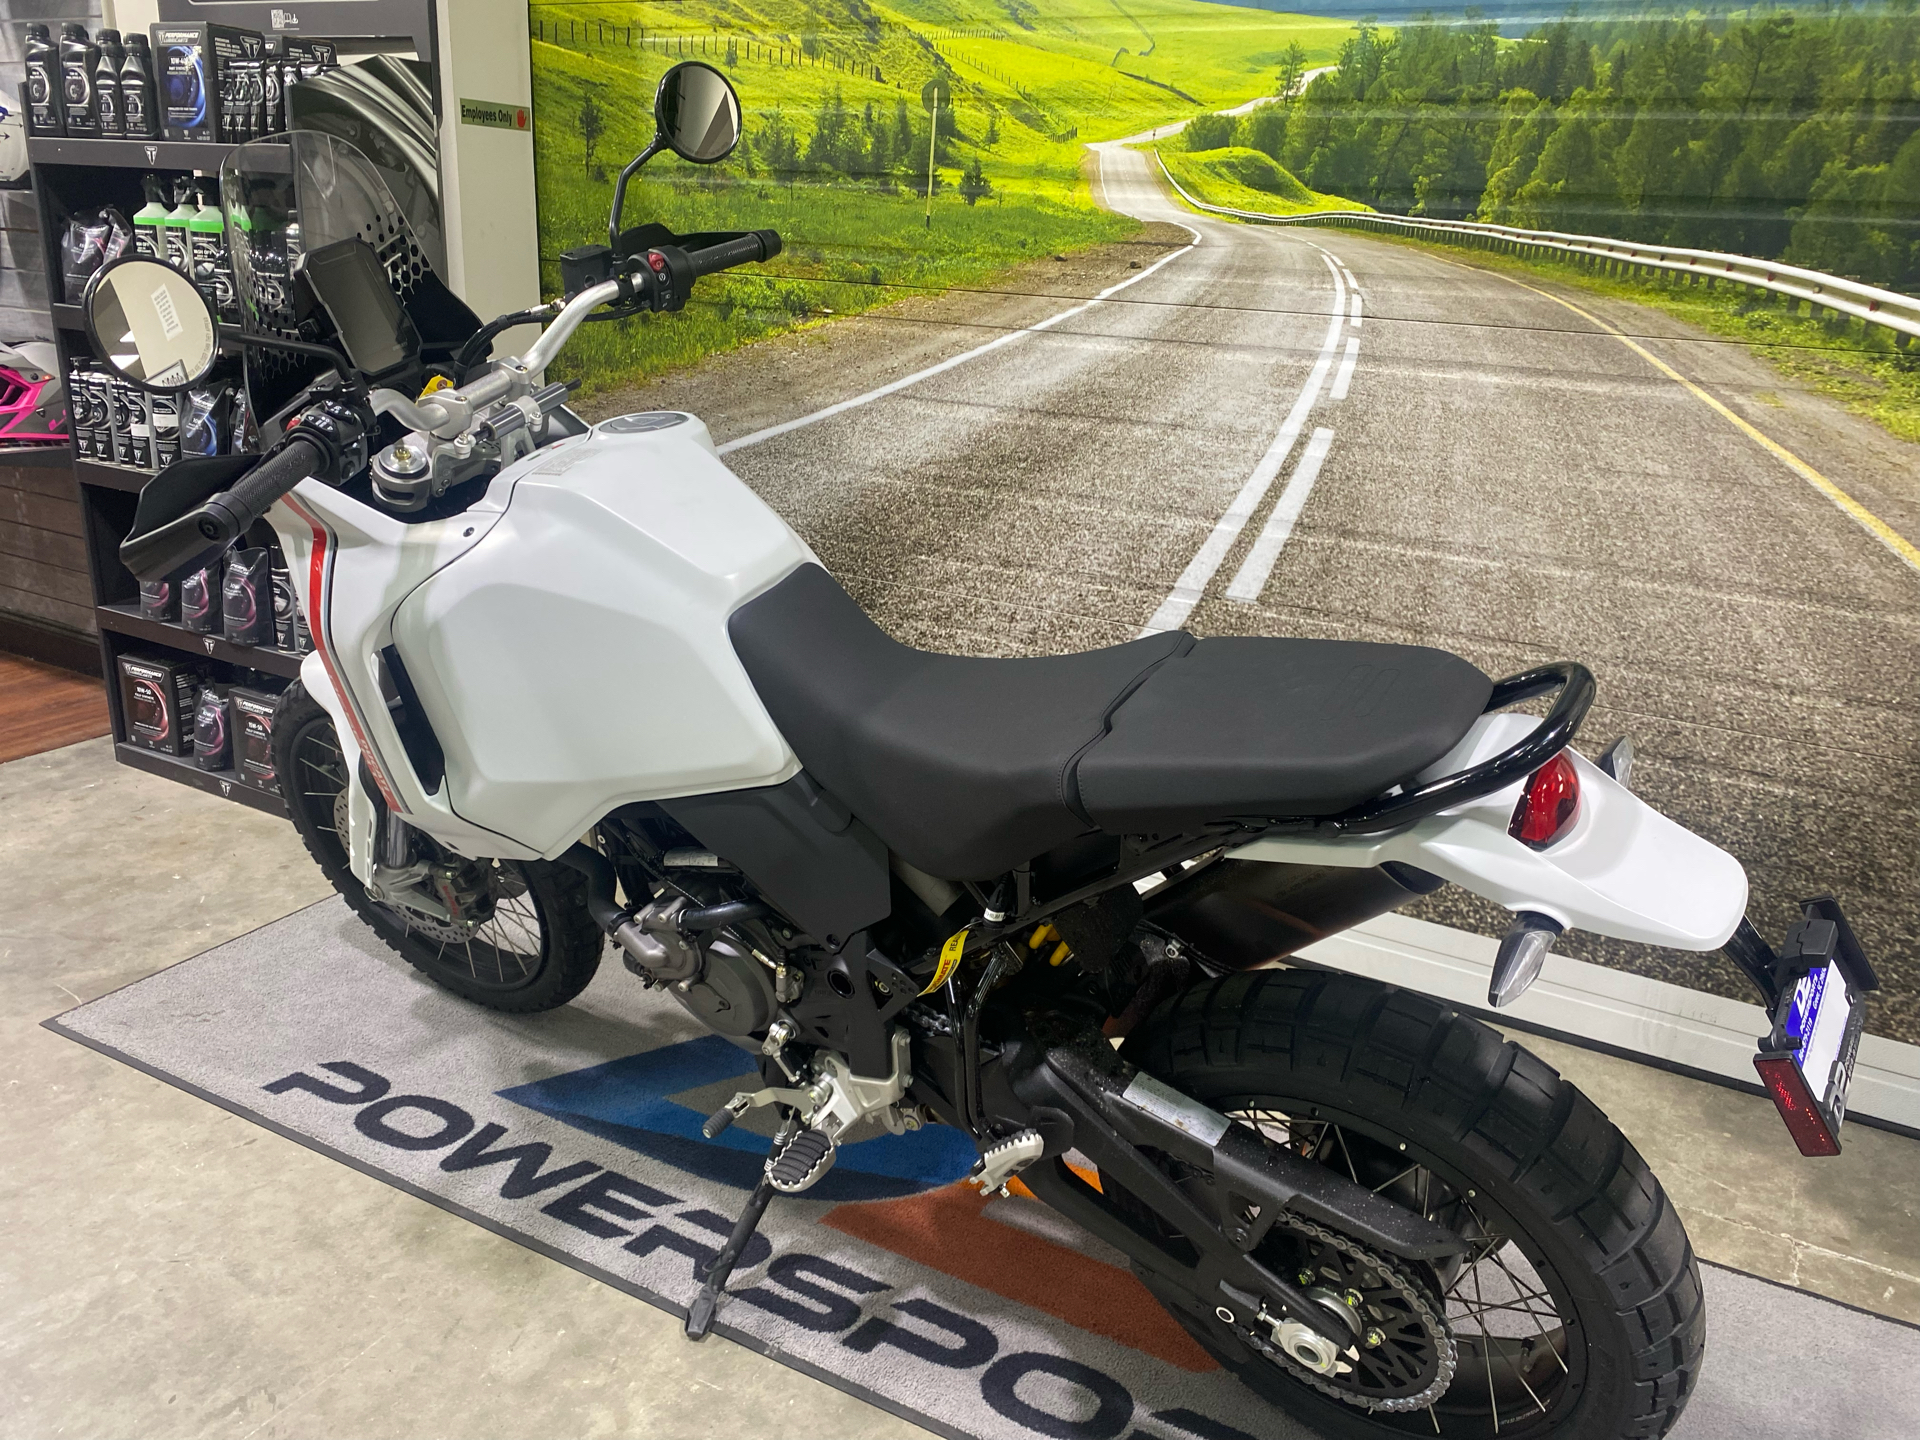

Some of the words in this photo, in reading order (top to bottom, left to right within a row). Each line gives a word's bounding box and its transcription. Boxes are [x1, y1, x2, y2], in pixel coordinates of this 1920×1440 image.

[461, 105, 497, 124] Employees
[498, 110, 512, 126] Only
[361, 739, 390, 792] DUCATI
